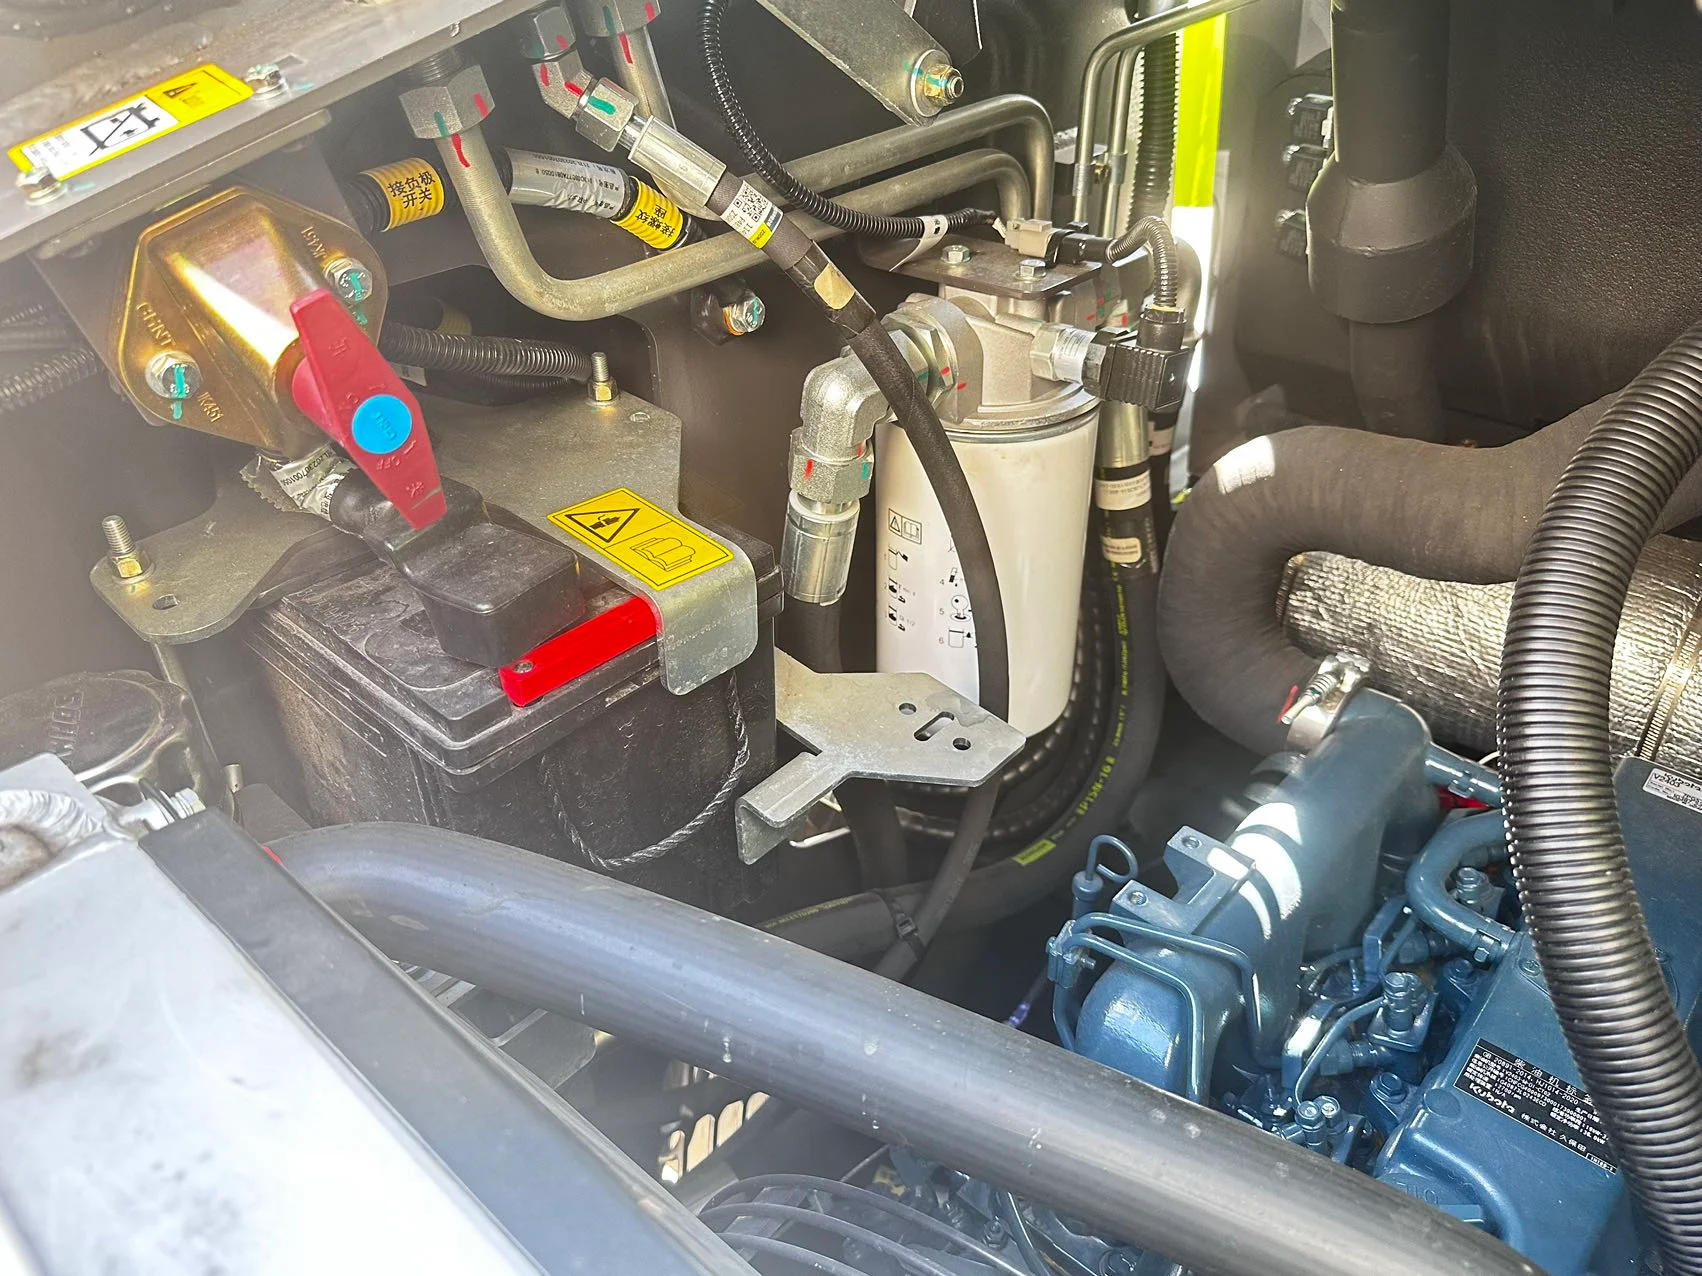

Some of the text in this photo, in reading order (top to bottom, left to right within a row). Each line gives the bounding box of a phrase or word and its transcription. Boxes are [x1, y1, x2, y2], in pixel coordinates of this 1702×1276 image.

[387, 171, 435, 198] 接负极
[402, 187, 432, 209] 开关
[636, 209, 676, 238] 接螺纹
[136, 302, 176, 347] CHINT
[1467, 1082, 1587, 1152] Kubota 株式会社 久保田
